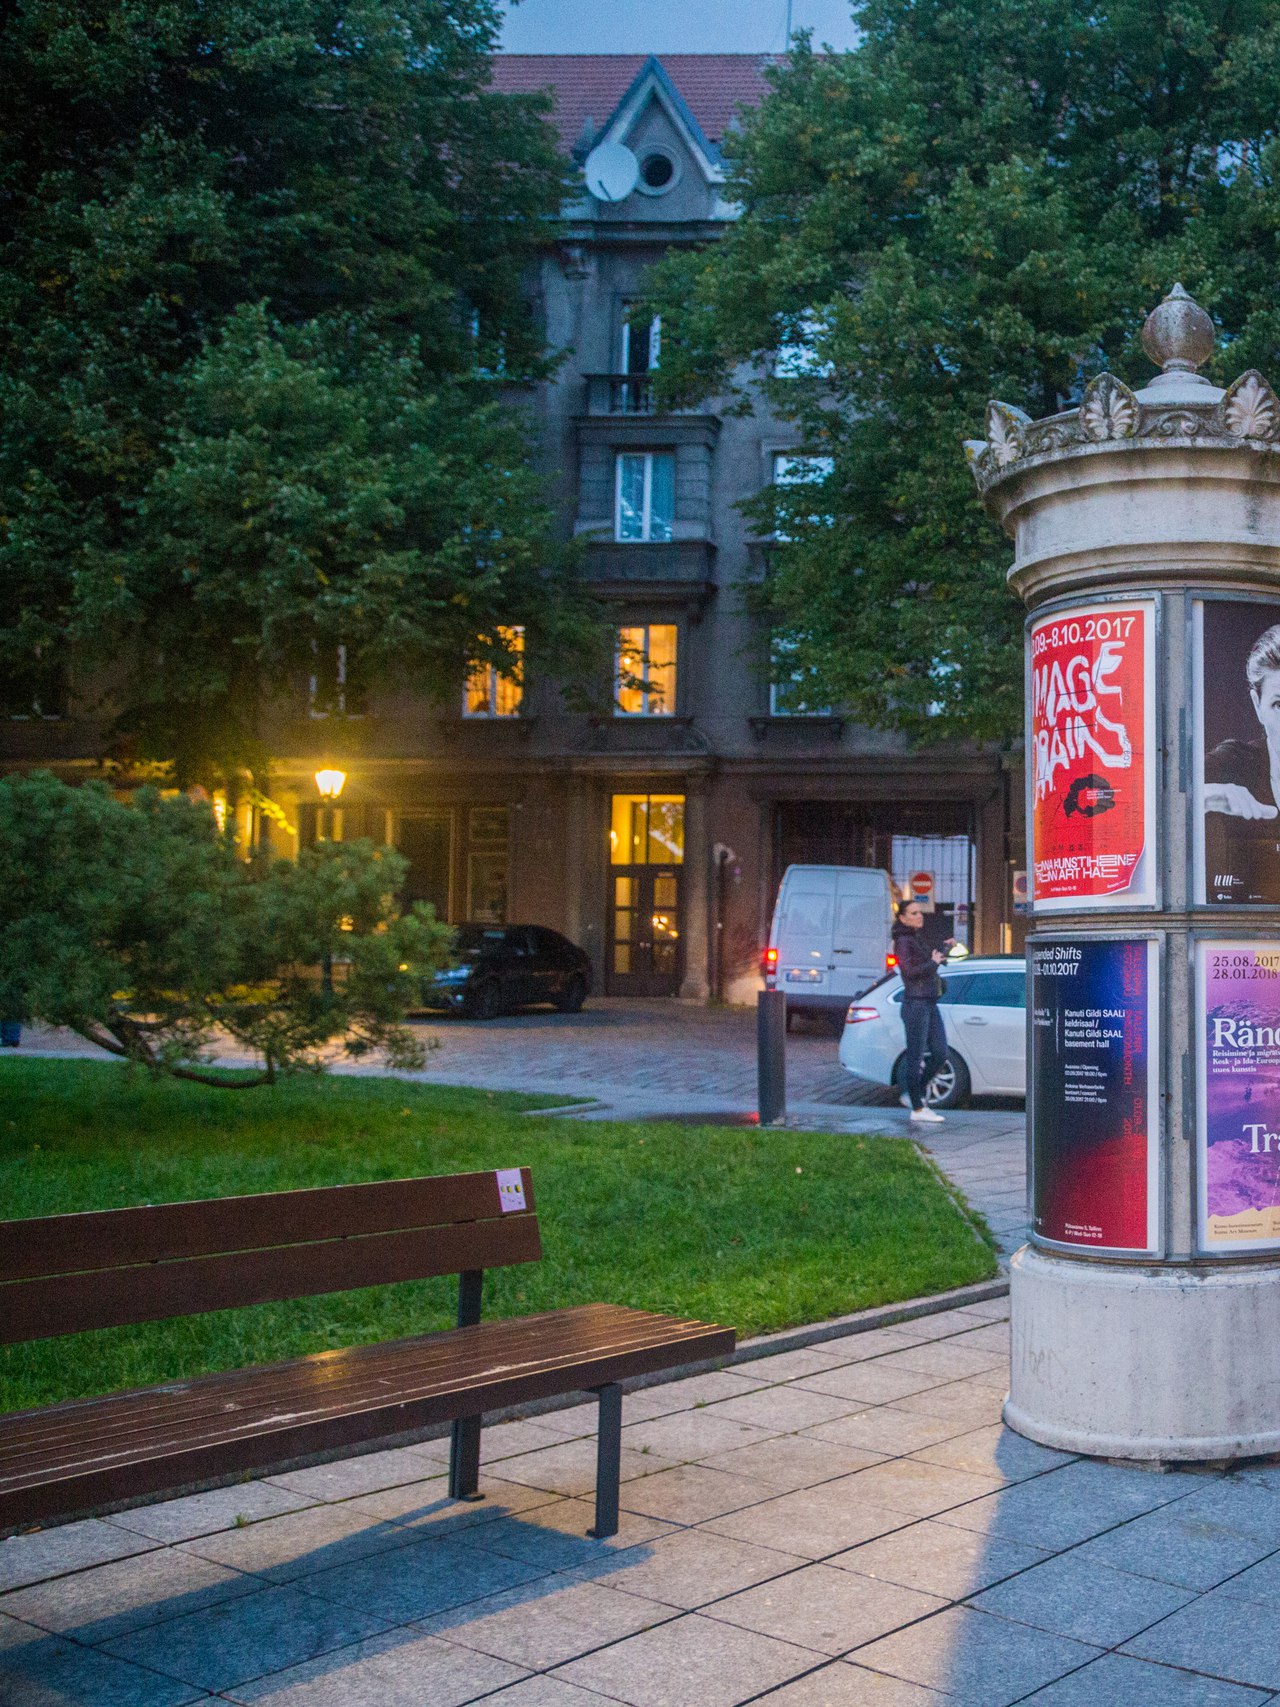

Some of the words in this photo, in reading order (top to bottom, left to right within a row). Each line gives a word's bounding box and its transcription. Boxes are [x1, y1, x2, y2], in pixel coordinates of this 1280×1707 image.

[1058, 867, 1081, 880] ART
[1055, 947, 1082, 960] Shifts
[1213, 968, 1278, 980] 28.01.2018
[1064, 1009, 1085, 1017] Kanuti
[1086, 1009, 1101, 1017] Gildi
[1064, 1019, 1095, 1027] keldrisaal
[1064, 1029, 1085, 1037] Kanuti
[1086, 1029, 1101, 1037] Gildi
[1102, 1030, 1124, 1038] SAAL
[1064, 1039, 1095, 1047] basement
[1096, 1039, 1110, 1048] hall
